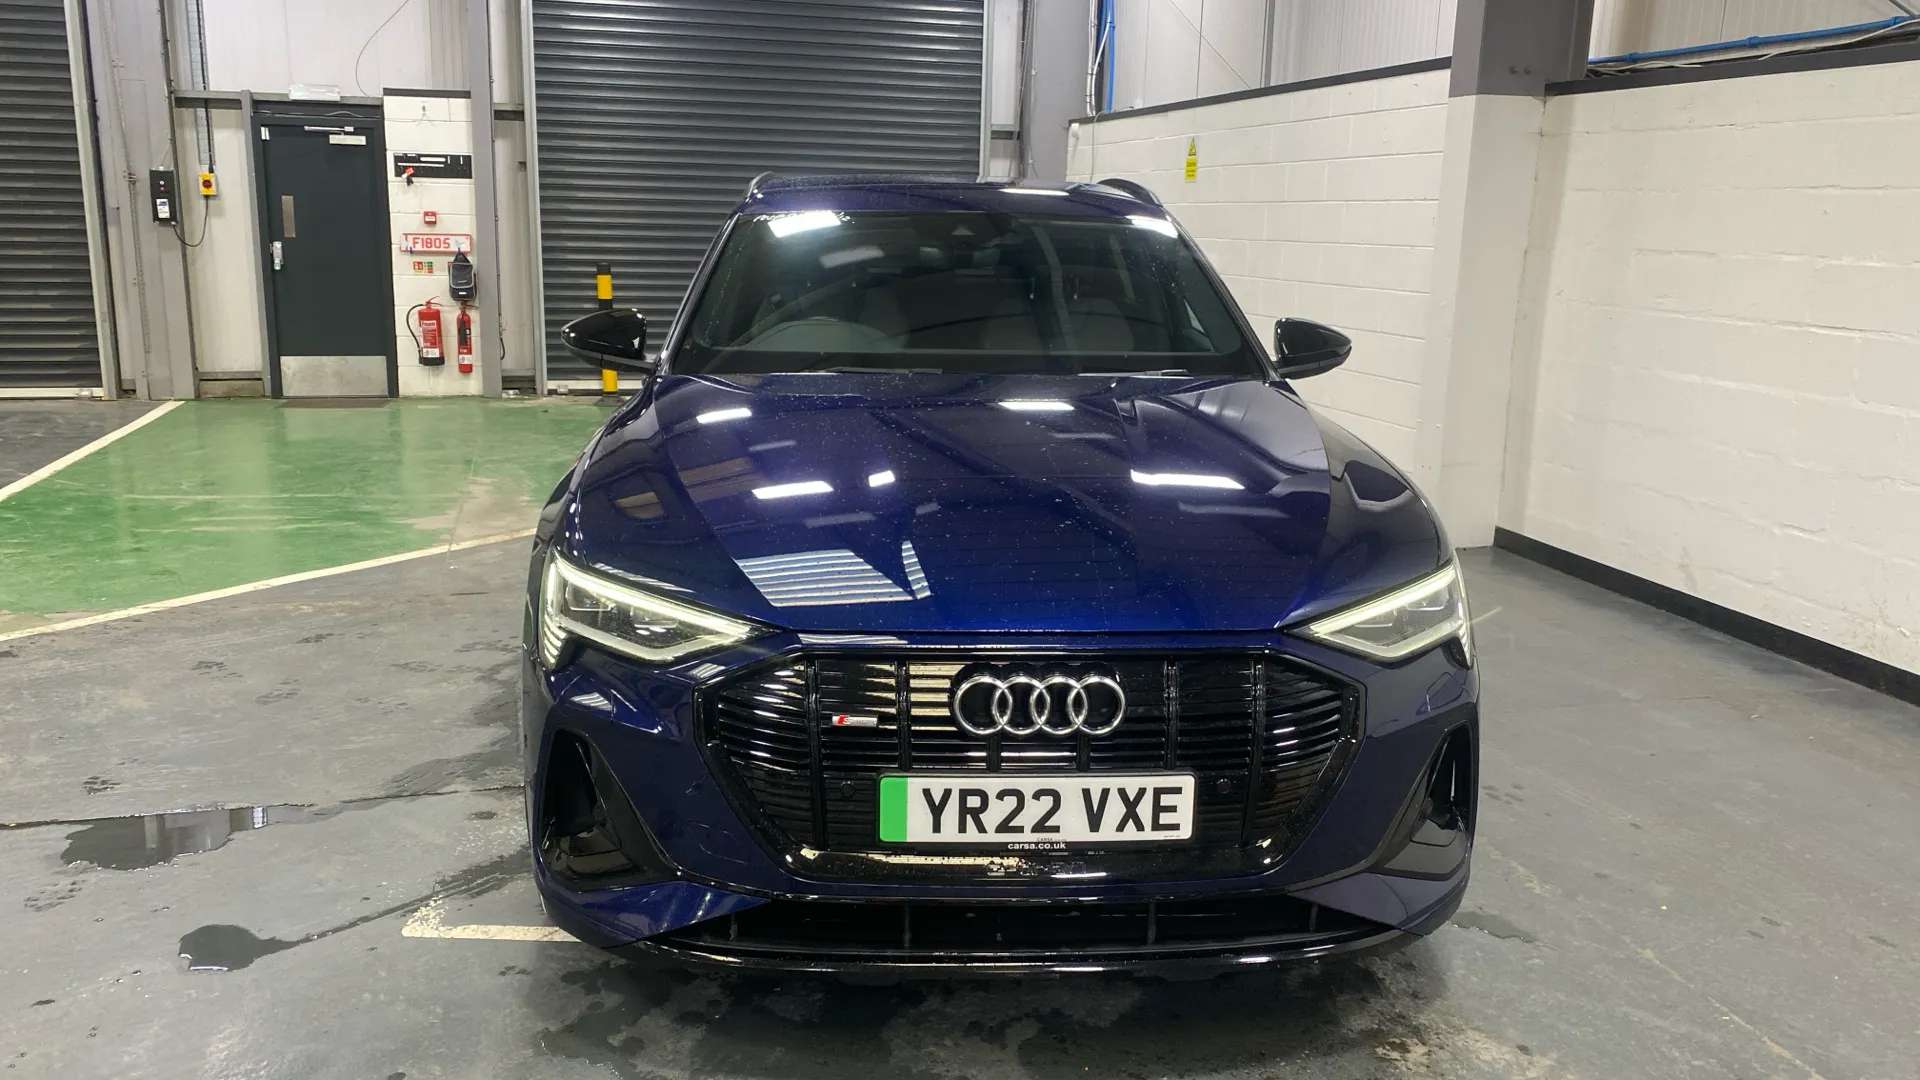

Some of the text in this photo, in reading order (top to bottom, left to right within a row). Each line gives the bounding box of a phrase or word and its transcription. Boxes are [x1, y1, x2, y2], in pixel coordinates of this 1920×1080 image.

[922, 786, 1183, 834] YR22 VXE
[1007, 842, 1066, 850] carsa.co.uk
